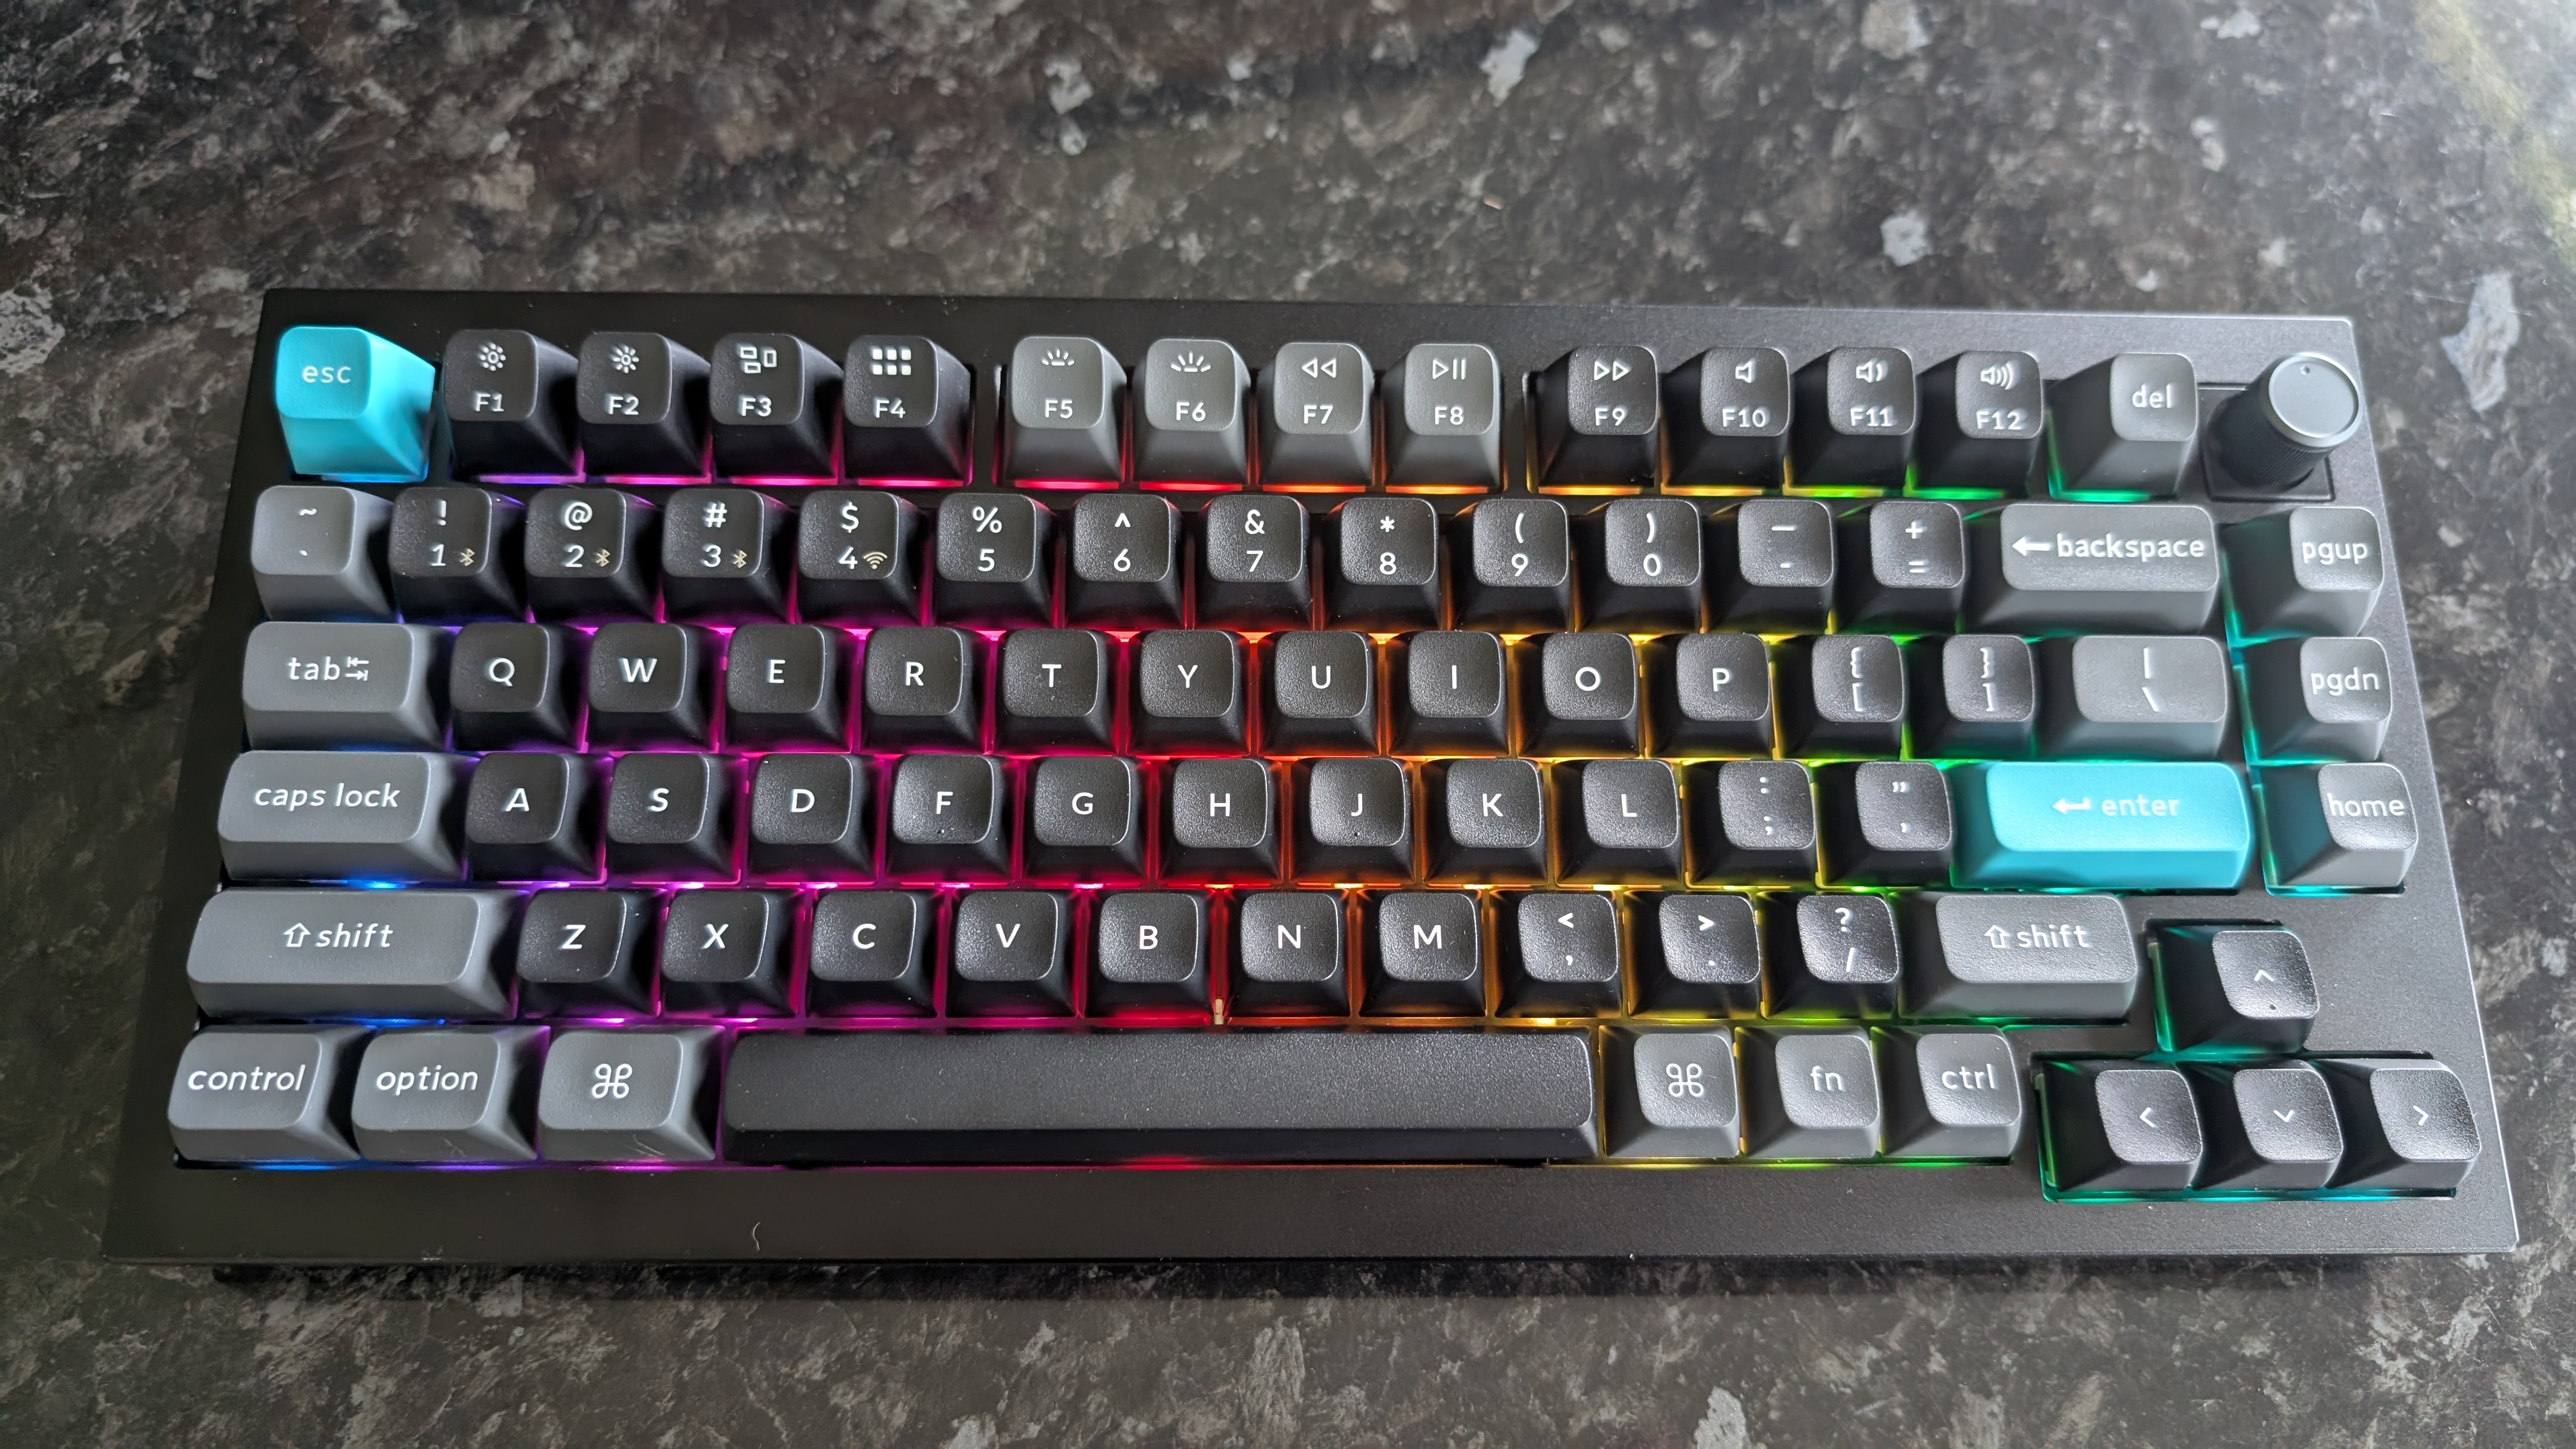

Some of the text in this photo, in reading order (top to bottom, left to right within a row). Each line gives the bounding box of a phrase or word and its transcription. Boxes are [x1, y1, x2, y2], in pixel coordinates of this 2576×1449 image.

[302, 365, 351, 384] esc
[475, 392, 504, 412] F1
[608, 394, 639, 415] F2
[740, 396, 772, 417] F3
[875, 397, 906, 418] F4
[2132, 383, 2173, 408] del
[1045, 399, 1073, 419] F5
[1176, 401, 1206, 422] F6
[1303, 404, 1333, 424] F7
[1434, 406, 1464, 425] F8
[1595, 406, 1626, 426] F9
[1722, 406, 1767, 427] F10
[1850, 406, 1893, 427] F11
[1976, 409, 2023, 431] F12
[438, 500, 447, 526] !
[564, 502, 593, 531] @
[705, 502, 728, 528] #
[841, 502, 859, 533] $
[972, 506, 1002, 533] %
[1114, 512, 1131, 528] ^
[1245, 509, 1265, 535] &
[1515, 512, 1524, 544] (
[1646, 512, 1656, 544] )
[1905, 521, 1924, 539] +
[431, 544, 446, 567] 1
[565, 544, 585, 568] 2
[702, 544, 721, 567] 3
[838, 546, 858, 570] 4
[977, 548, 995, 572] 5
[1114, 548, 1131, 572] 6
[2057, 532, 2205, 563] backspace
[2301, 540, 2368, 565] pgup
[1246, 550, 1264, 572] 7
[1379, 552, 1397, 575] 8
[1511, 553, 1529, 577] 9
[1643, 553, 1662, 577] 0
[1908, 560, 1927, 573] =
[288, 656, 341, 680] tab
[488, 657, 515, 687] Q
[621, 657, 657, 683] W
[768, 659, 786, 684] E
[905, 661, 924, 686] R
[1850, 646, 1861, 678] {
[1980, 647, 1991, 678] }
[1041, 663, 1062, 688] T
[1177, 664, 1198, 689] Y
[1311, 665, 1331, 689] U
[1452, 664, 1457, 689] I
[1575, 666, 1601, 691] O
[1712, 668, 1730, 692] P
[2310, 667, 2380, 696] pgdn
[1851, 682, 1864, 712] [
[1982, 683, 1995, 712] ]
[254, 783, 401, 811] caps lock
[504, 788, 530, 812] A
[648, 788, 670, 812] S
[790, 788, 815, 813] D
[935, 791, 953, 815] F
[1071, 792, 1094, 815] G
[1209, 793, 1230, 817] H
[1351, 793, 1363, 817] J
[1482, 793, 1503, 817] K
[1621, 793, 1637, 818] L
[2101, 794, 2179, 816] enter
[2327, 792, 2405, 818] home
[1558, 912, 1574, 928] <
[1698, 915, 1715, 931] >
[1834, 907, 1851, 933] ?
[316, 923, 394, 948] shift
[560, 924, 586, 949] Z
[702, 923, 729, 949] X
[852, 923, 877, 949] C
[995, 923, 1021, 948] V
[1139, 925, 1158, 950] B
[1277, 924, 1301, 949] N
[1413, 924, 1442, 949] M
[2016, 924, 2092, 949] shift
[1845, 947, 1857, 974] /
[188, 1064, 306, 1091] control
[376, 1068, 479, 1096] option
[1810, 1065, 1844, 1091] fn
[1941, 1064, 1995, 1090] ctrl
